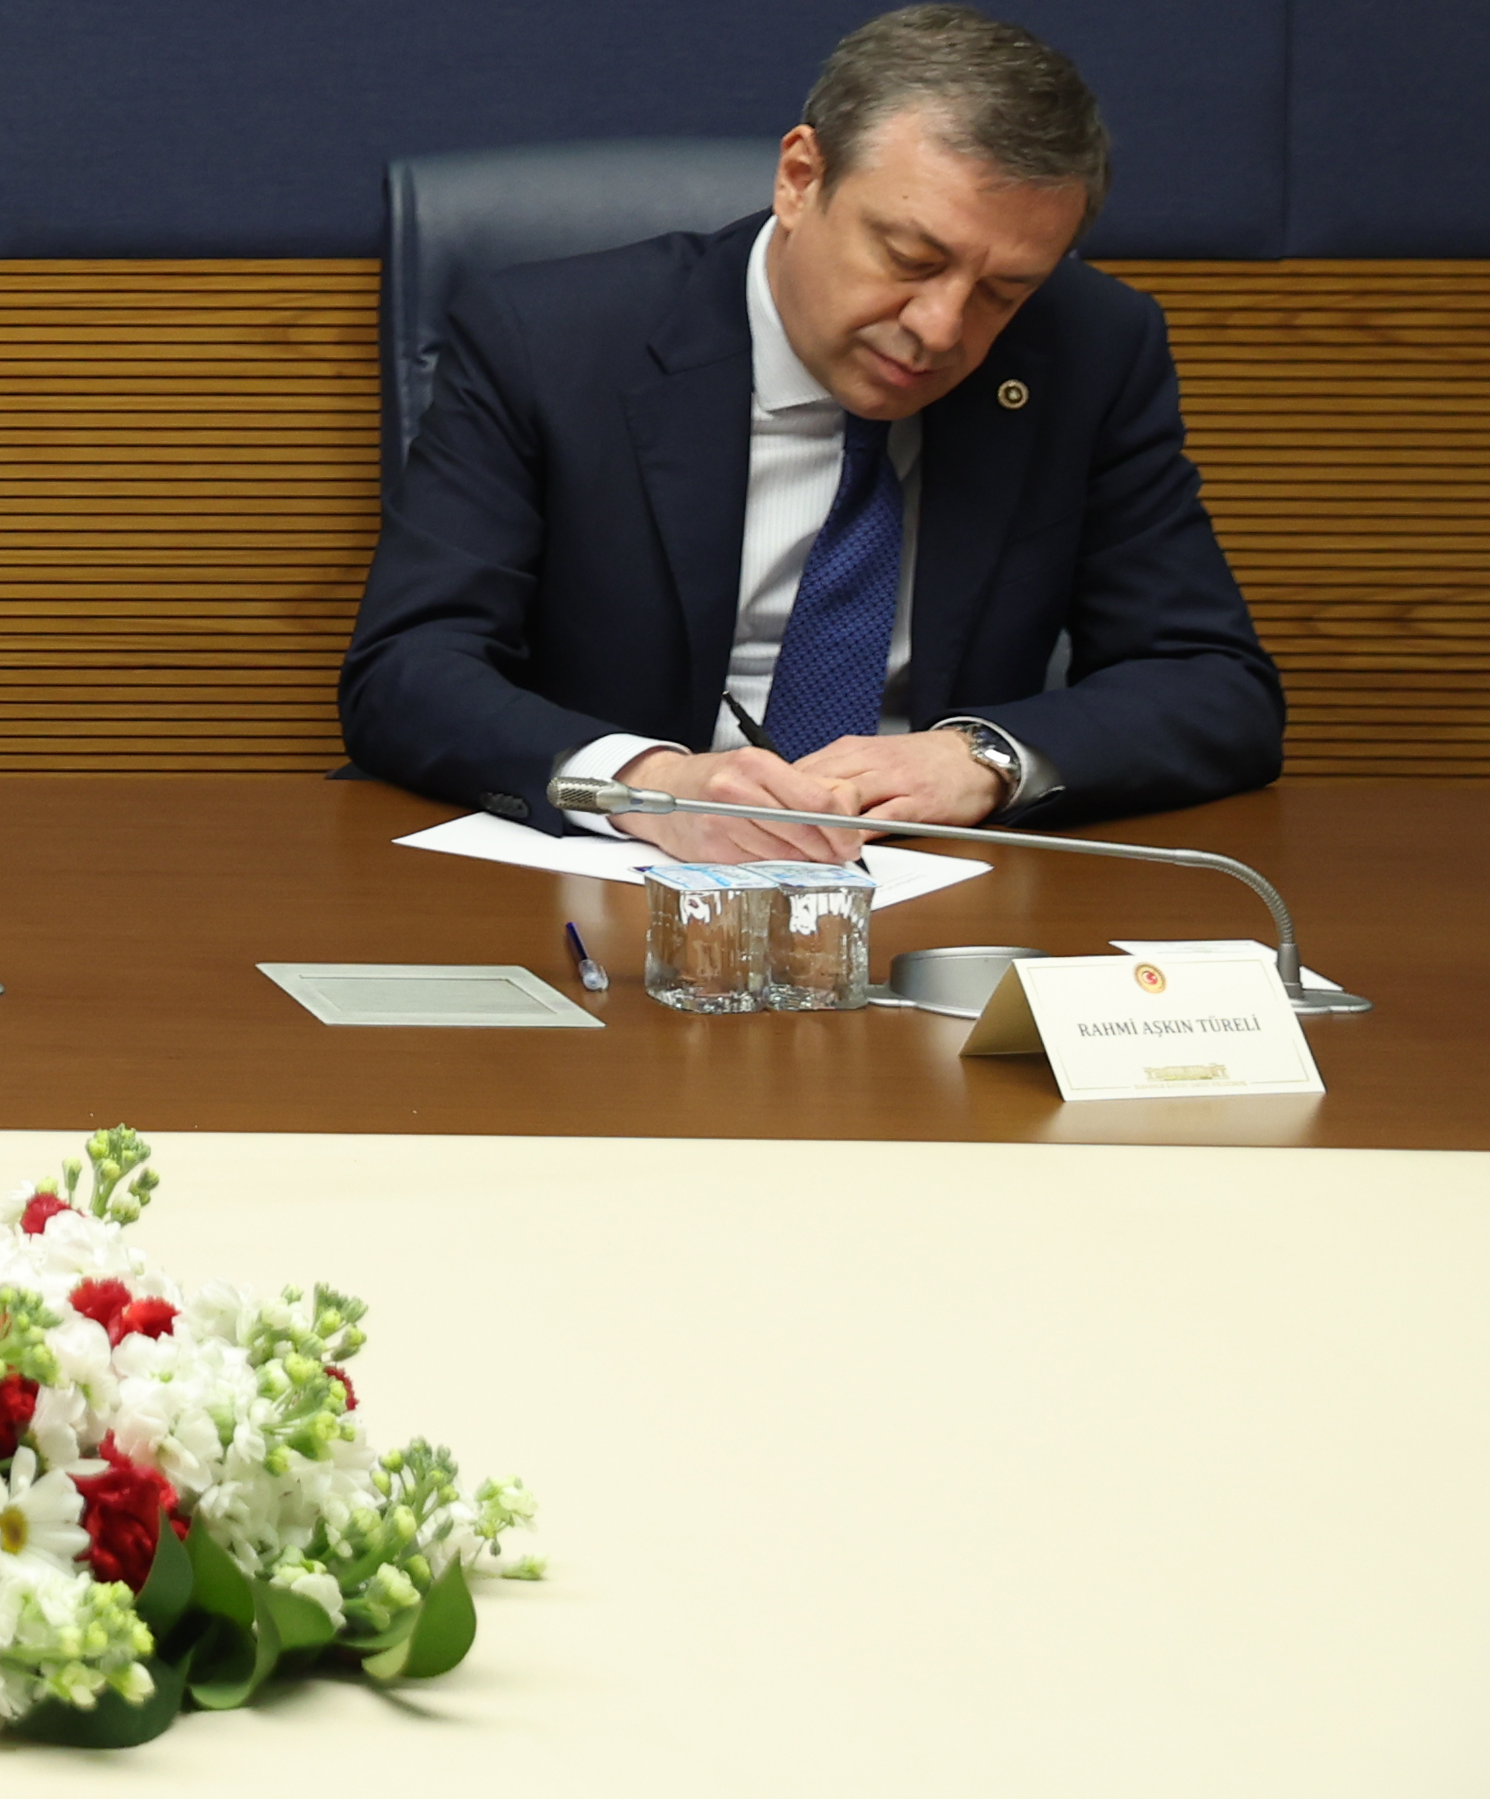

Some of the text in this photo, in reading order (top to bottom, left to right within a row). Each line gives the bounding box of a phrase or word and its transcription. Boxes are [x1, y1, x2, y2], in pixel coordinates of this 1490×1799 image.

[1077, 1014, 1262, 1038] RAHMİ AŞKIN TÜRELİ
